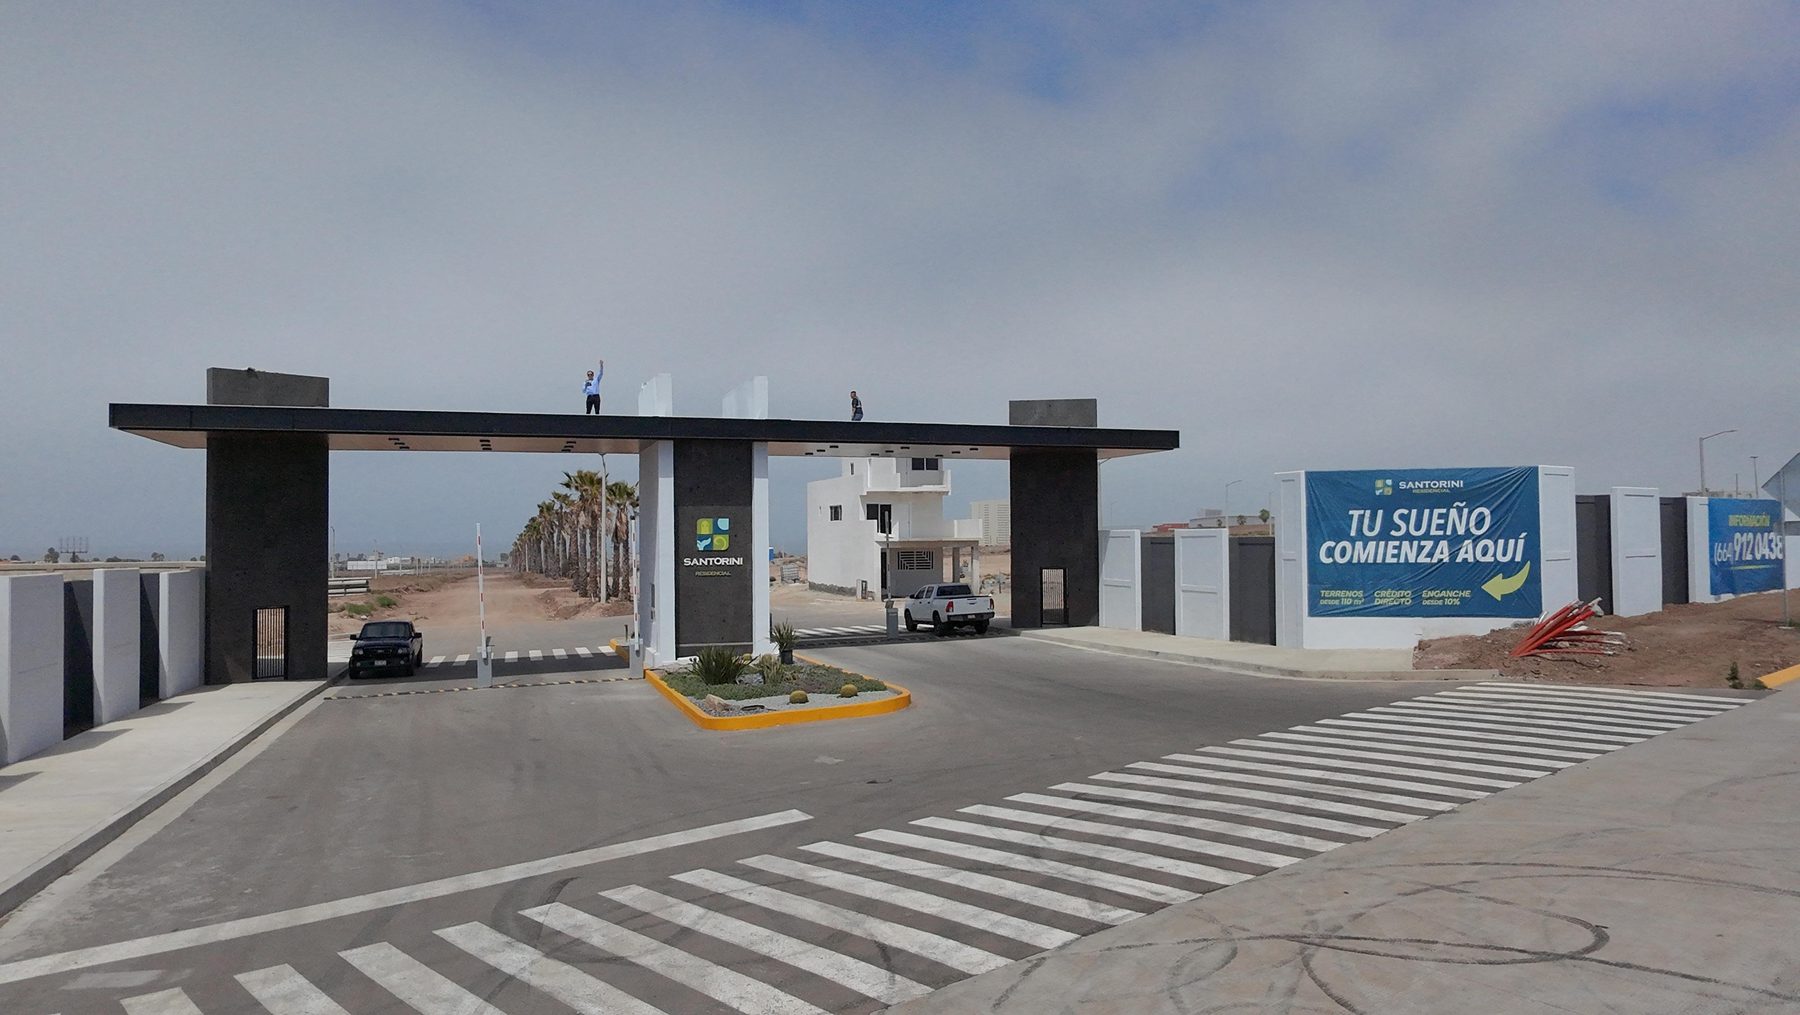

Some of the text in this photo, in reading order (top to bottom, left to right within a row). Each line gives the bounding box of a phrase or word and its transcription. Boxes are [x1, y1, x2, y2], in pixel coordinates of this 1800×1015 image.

[1399, 480, 1464, 489] SANTORINI
[1348, 501, 1491, 537] TU SUEÑO
[1319, 532, 1528, 564] COMIENZA AQUÍ
[1734, 531, 1754, 561] 912
[683, 557, 744, 566] SANTORINI
[1320, 590, 1364, 598] TERRENOS
[1374, 588, 1412, 598] CRÉDITO
[1422, 590, 1471, 598] ENGANCHE
[1374, 598, 1412, 606] DIRECTO
[1444, 598, 1460, 606] 10%
